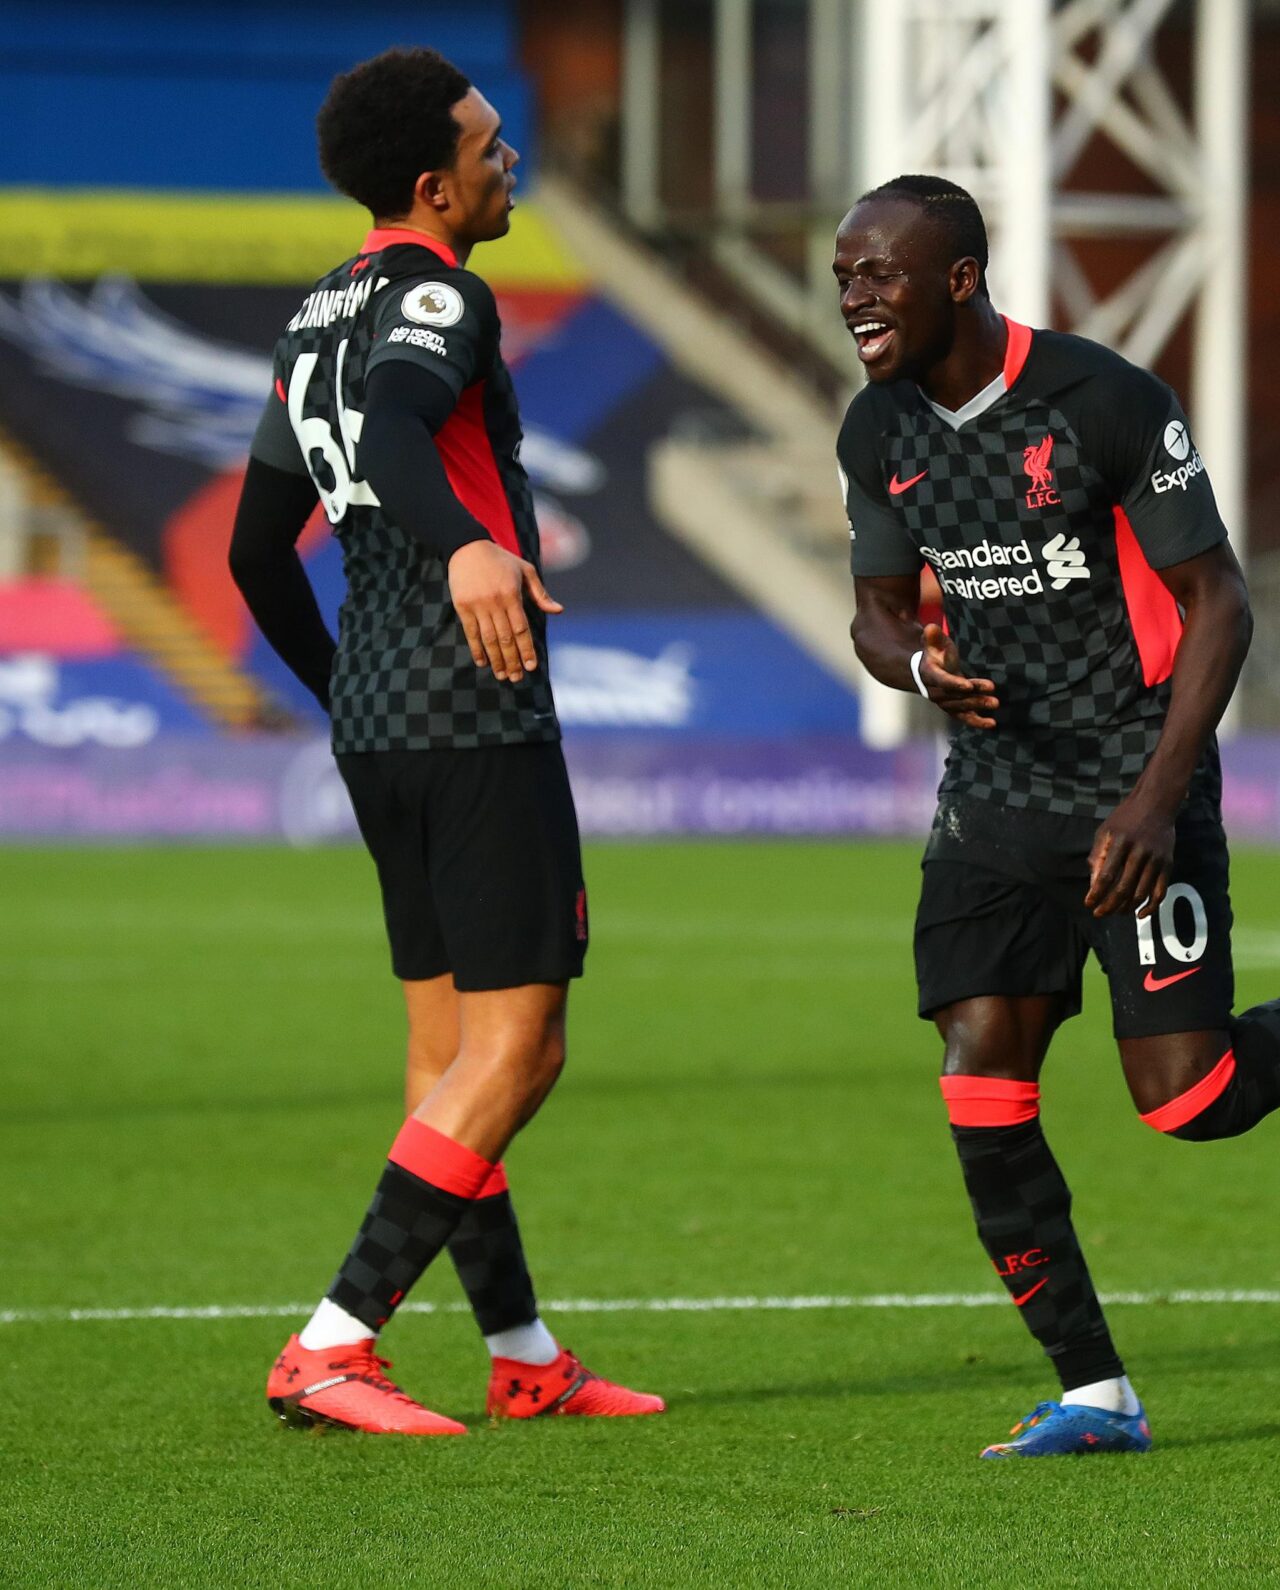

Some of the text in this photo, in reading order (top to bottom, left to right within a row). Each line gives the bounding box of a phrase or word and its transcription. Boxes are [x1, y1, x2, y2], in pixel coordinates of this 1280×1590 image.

[405, 335, 447, 357] racism
[409, 328, 445, 347] room
[1151, 449, 1204, 494] Expedi
[919, 539, 1033, 570] Standard
[937, 568, 1044, 600] hartered
[1134, 882, 1208, 966] 10
